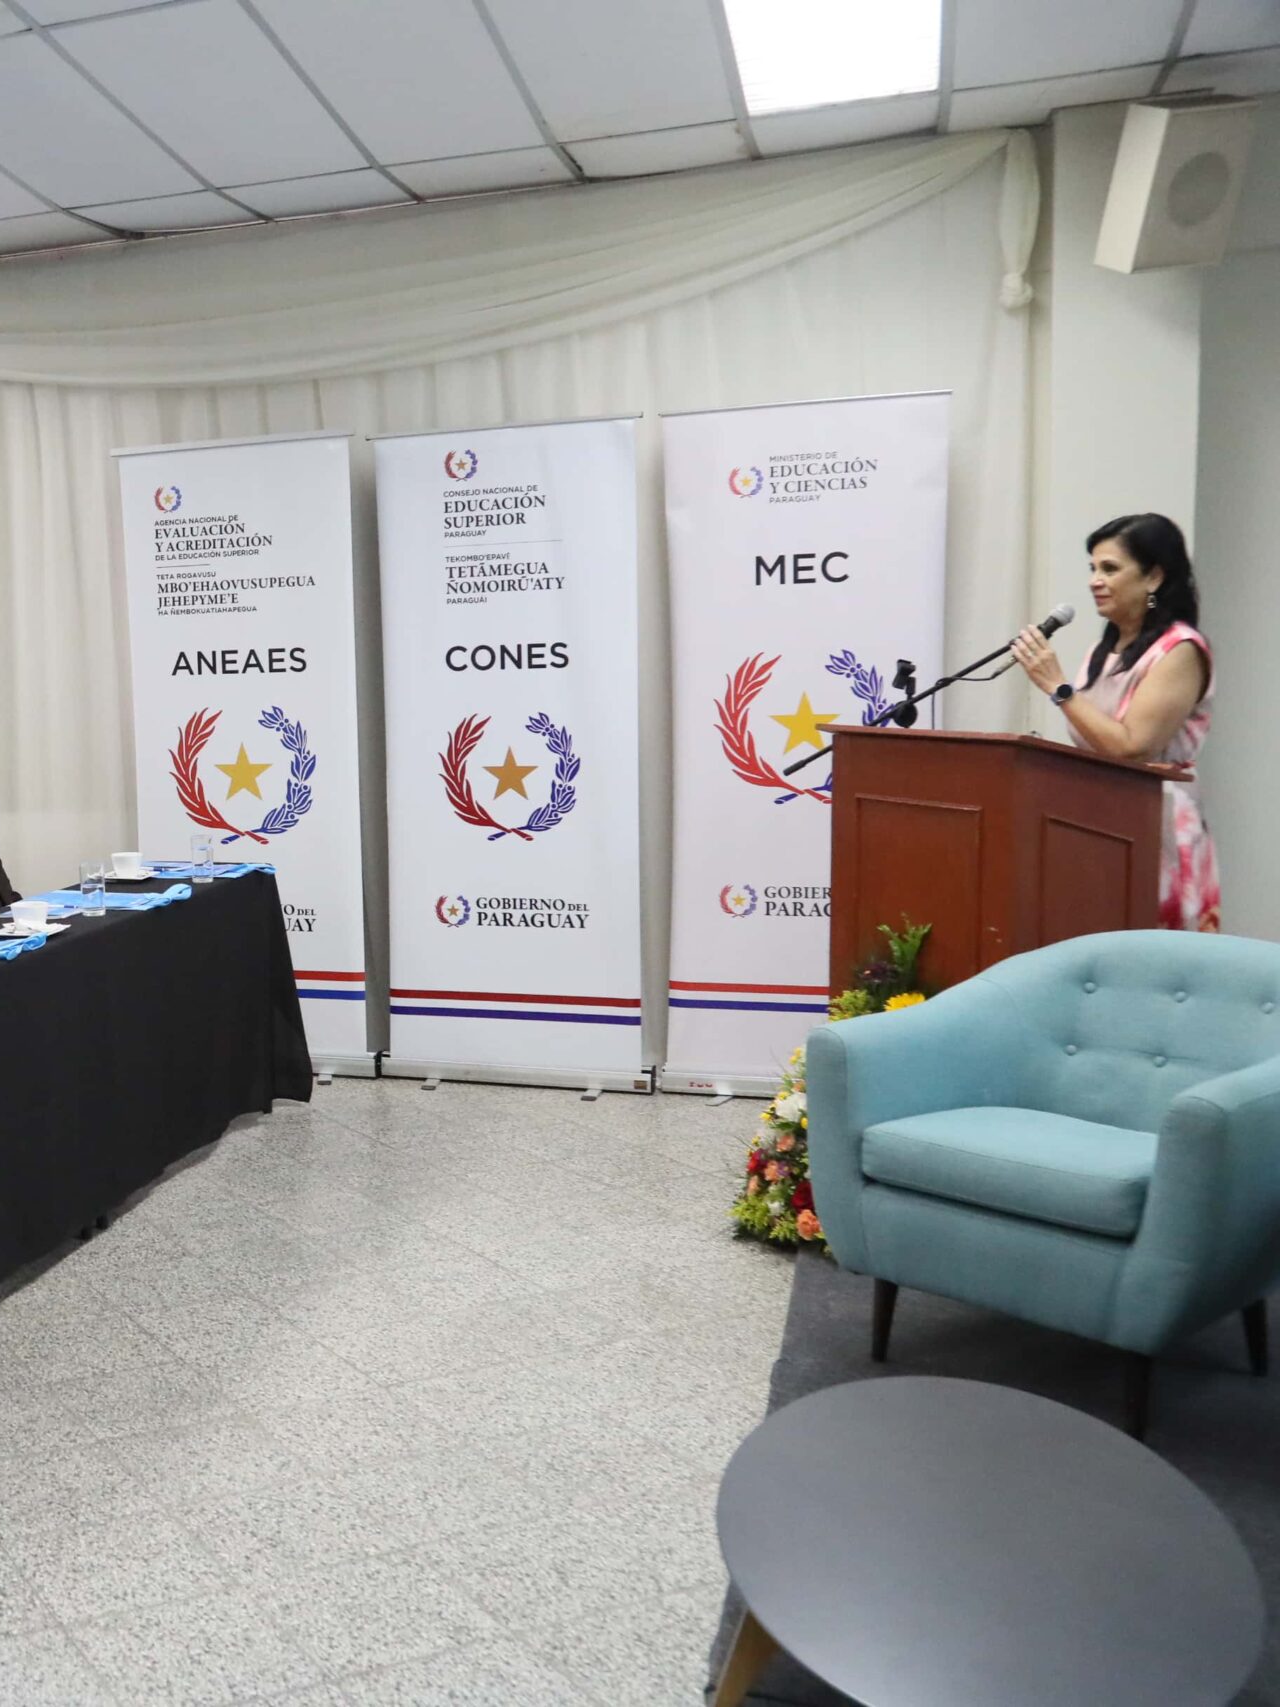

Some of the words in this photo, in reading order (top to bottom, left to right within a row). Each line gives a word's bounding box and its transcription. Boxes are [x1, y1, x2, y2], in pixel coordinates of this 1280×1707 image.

[769, 452, 822, 462] MINISTERIO
[825, 451, 838, 459] DE
[769, 457, 879, 478] EDUCACIÓN
[443, 488, 481, 498] CONSEJO
[482, 486, 524, 495] NACIONAL
[527, 484, 538, 492] DE
[770, 482, 781, 494] Y
[784, 476, 868, 494] CIENCIAS
[443, 492, 547, 514] EDUCACIÓN
[769, 494, 821, 503] PARAGUAY
[154, 518, 187, 527] AGENCIA
[189, 515, 227, 524] NACIONAL
[228, 514, 238, 522] DE
[154, 519, 245, 539] EVALUACIÓN
[443, 512, 526, 530] SUPERIOR
[154, 541, 164, 553] Y
[166, 532, 273, 553] ACREDITACIÓN
[444, 529, 487, 539] PARAGUAY
[167, 553, 177, 561] LA
[178, 550, 221, 560] EDUCACIÓN
[222, 548, 260, 558] SUPERIOR
[755, 551, 849, 586] MEC
[171, 647, 308, 676] ANEAES
[445, 642, 569, 672] CONES
[764, 886, 832, 899] GOBIER
[297, 908, 317, 916] DEL
[476, 897, 566, 912] GOBIERNO
[567, 903, 590, 912] DEL
[764, 901, 832, 917] PARA
[477, 911, 590, 929] PARAGUAY
